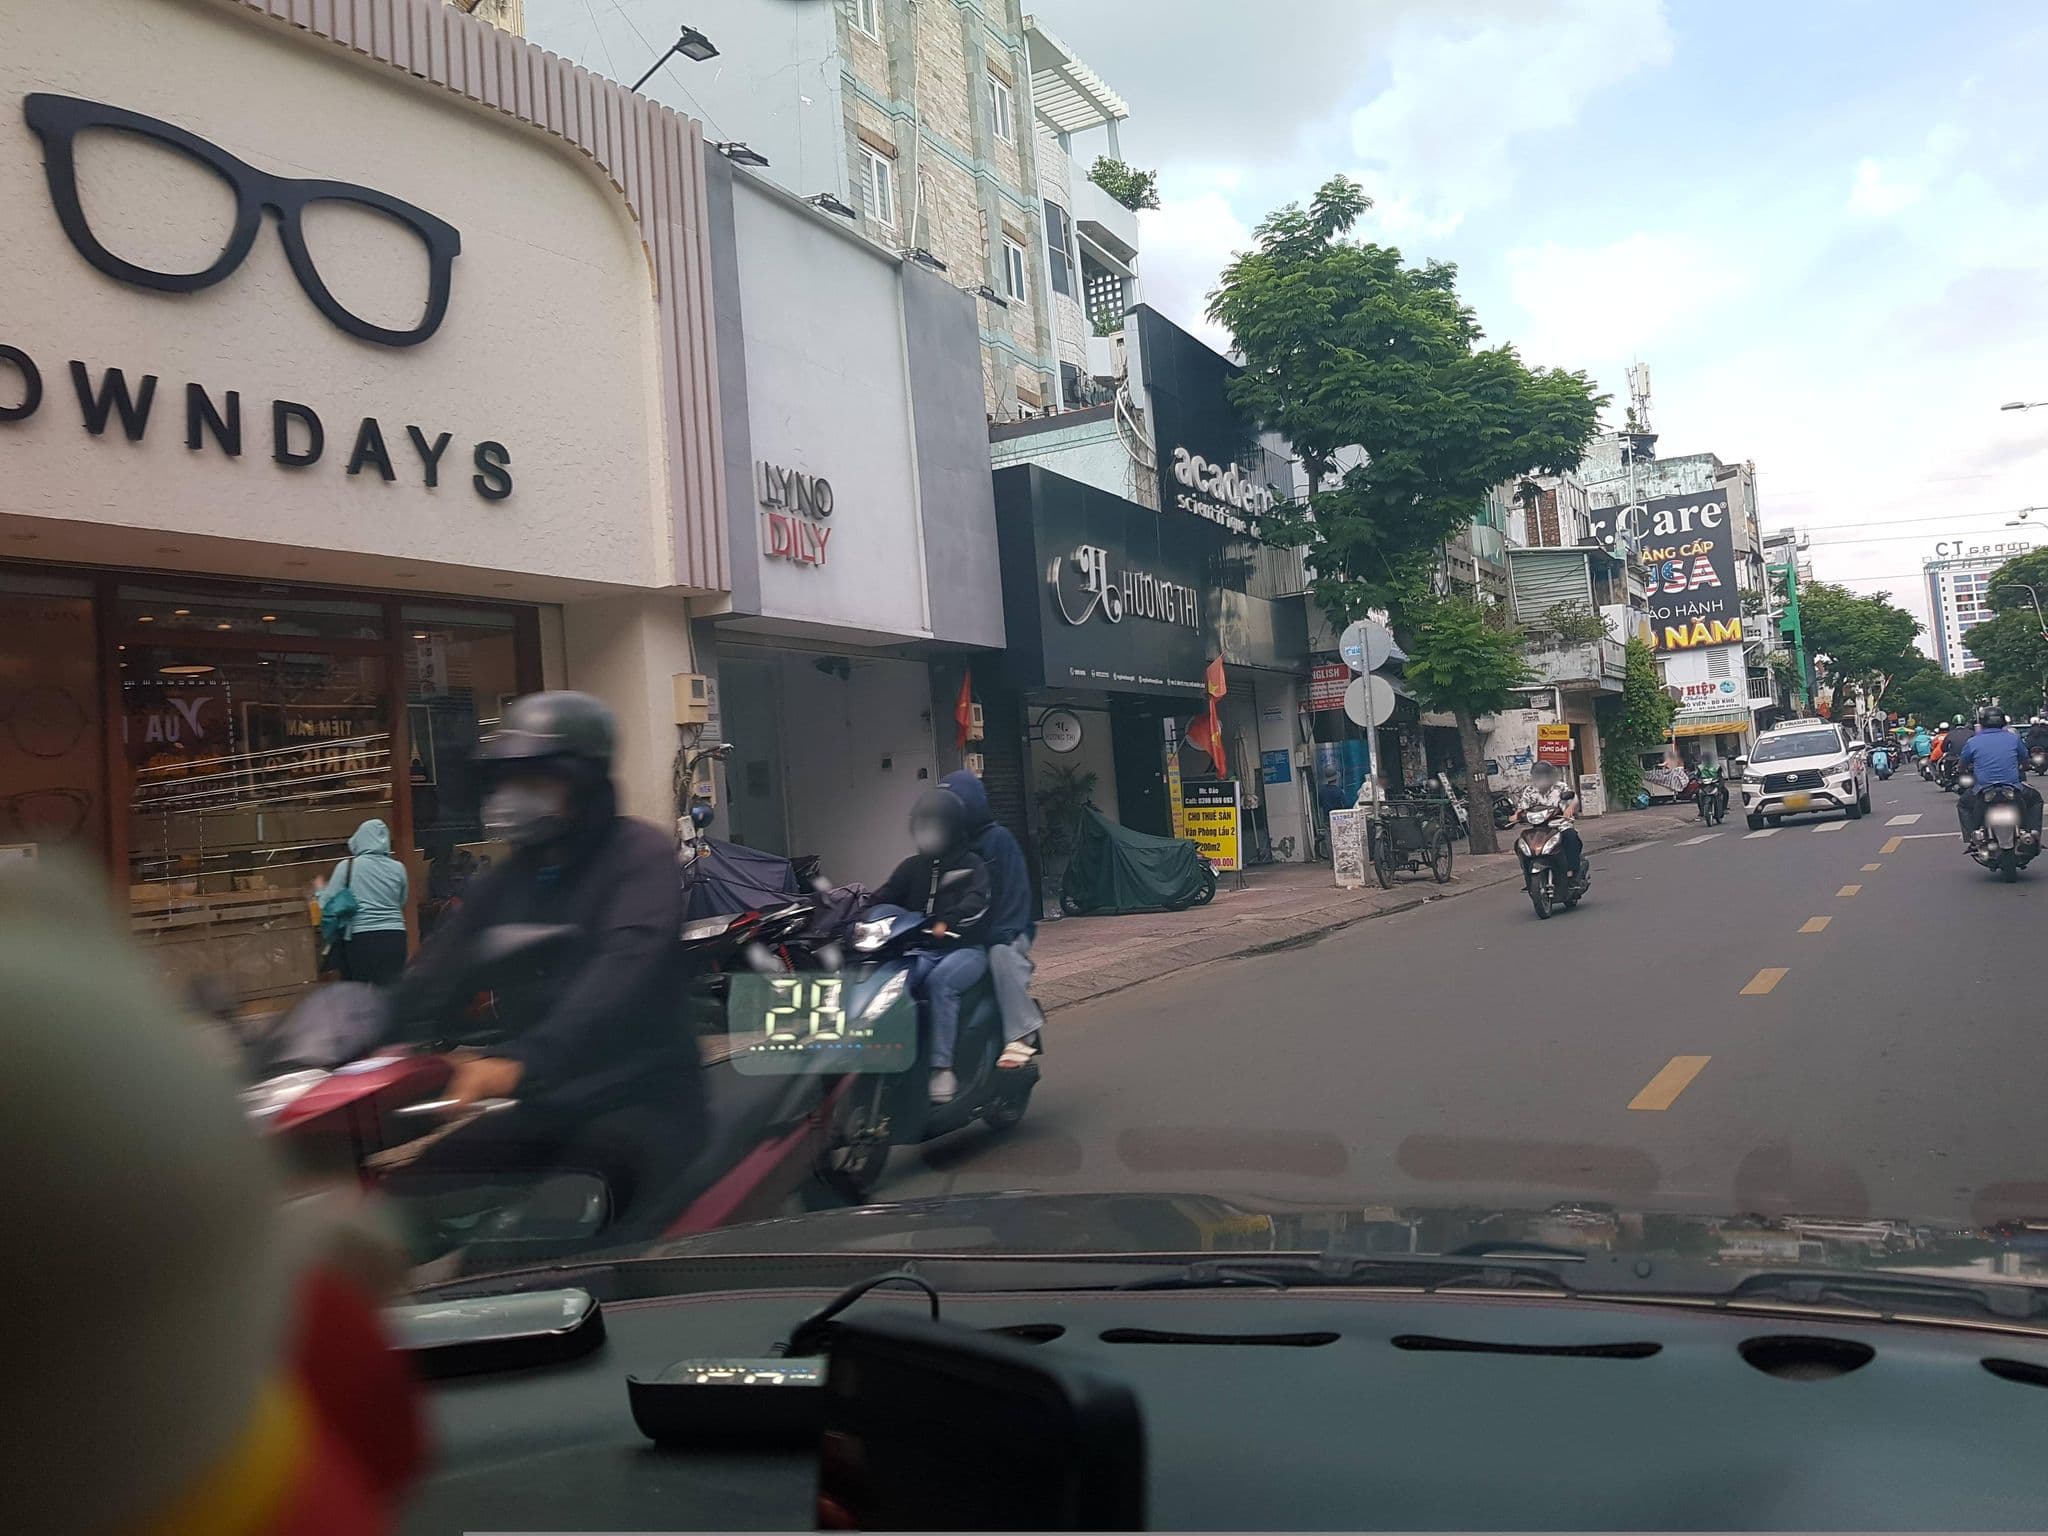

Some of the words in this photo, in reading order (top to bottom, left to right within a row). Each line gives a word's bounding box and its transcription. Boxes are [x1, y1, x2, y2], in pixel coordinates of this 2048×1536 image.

[757, 461, 833, 520] LYNO
[1590, 501, 1722, 545] r.Care
[761, 512, 831, 567] DILY
[1680, 537, 1714, 556] CẤP
[1936, 540, 1963, 556] CT
[1650, 604, 1671, 620] ẢO
[1675, 599, 1724, 617] HÀNH
[1188, 812, 1200, 821] CHO
[1231, 826, 1236, 836] 2
